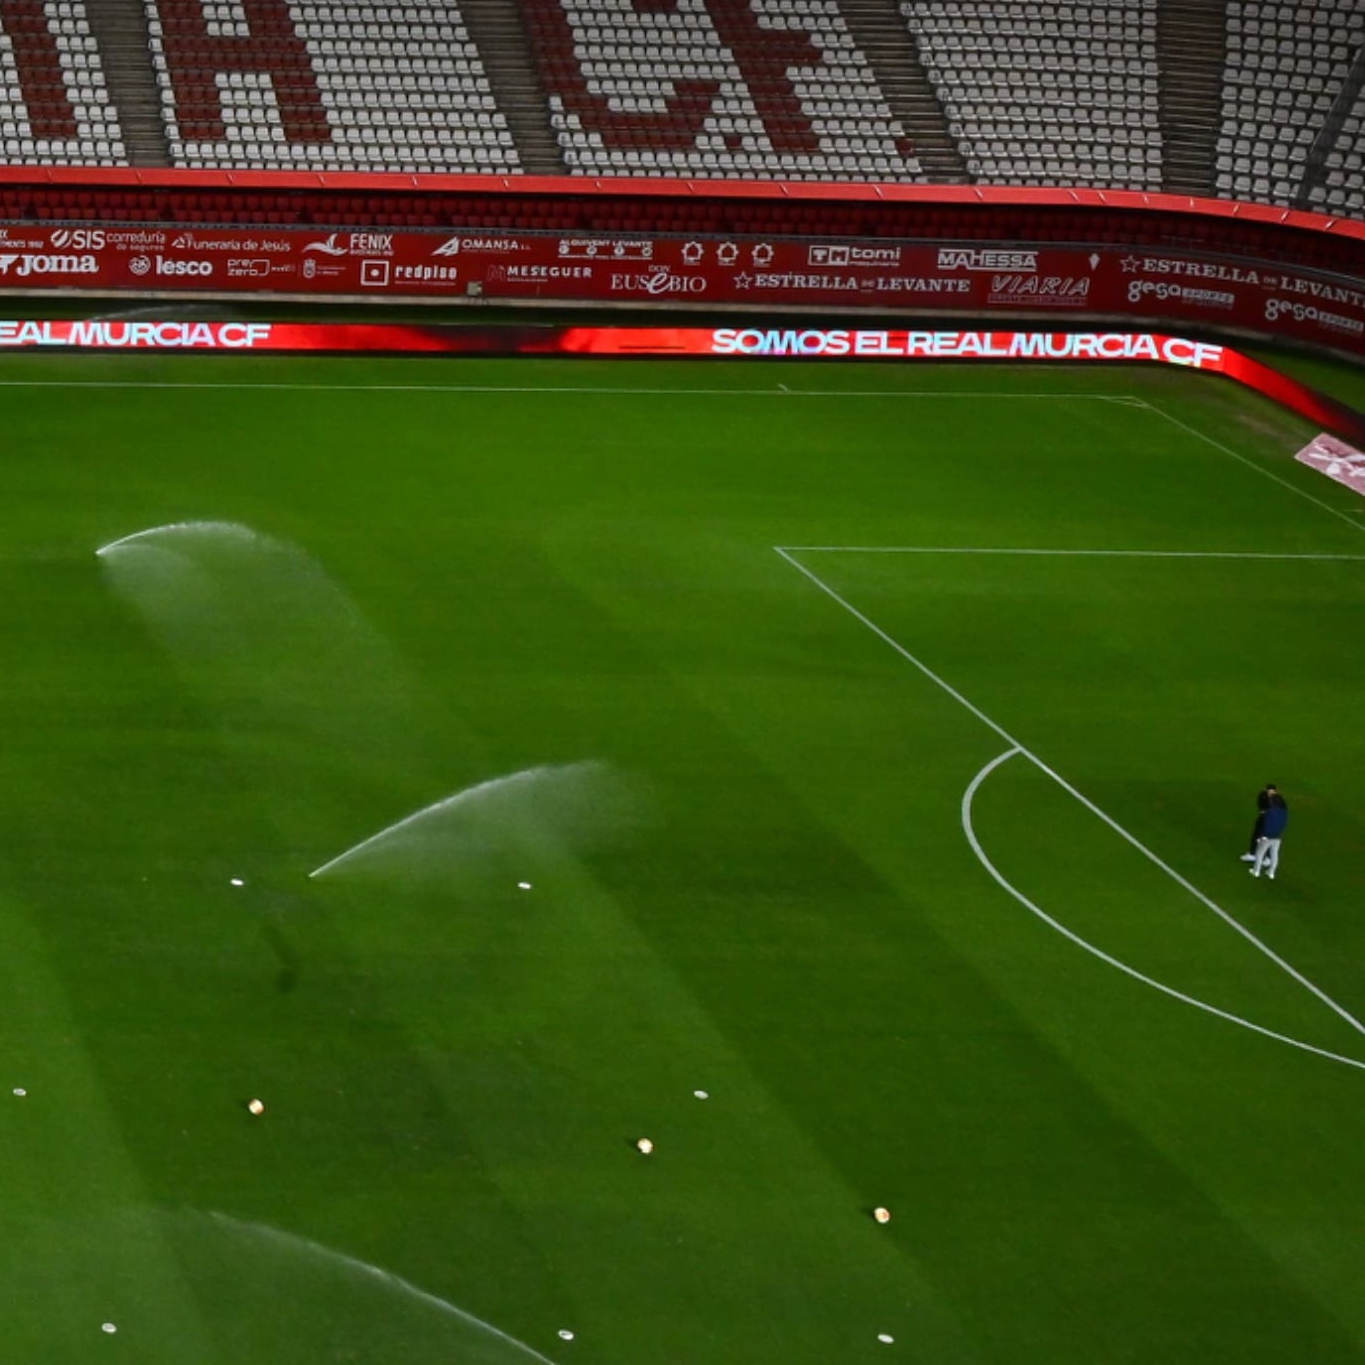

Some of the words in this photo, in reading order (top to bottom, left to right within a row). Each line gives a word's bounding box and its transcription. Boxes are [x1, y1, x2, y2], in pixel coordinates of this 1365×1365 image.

[72, 230, 105, 250] SIS
[243, 238, 257, 250] de
[350, 234, 393, 250] FENIX
[462, 239, 518, 251] OMANSA
[851, 246, 901, 260] tomi
[937, 248, 1038, 272] MAHESSA
[156, 254, 212, 276] lesco
[507, 265, 592, 278] MESEGUER
[1143, 258, 1260, 285] ESTRELLA
[756, 273, 858, 290] ESTRELLA
[877, 277, 971, 292] LEVANTE
[991, 275, 1090, 296] VIARIA
[69, 322, 215, 346] MURCIA
[218, 323, 272, 348] CF
[711, 329, 851, 354] SOMOS
[855, 331, 904, 355] EL
[908, 331, 1008, 356] REAL
[1009, 333, 1160, 360] MURCIA
[1163, 338, 1223, 368] CF
